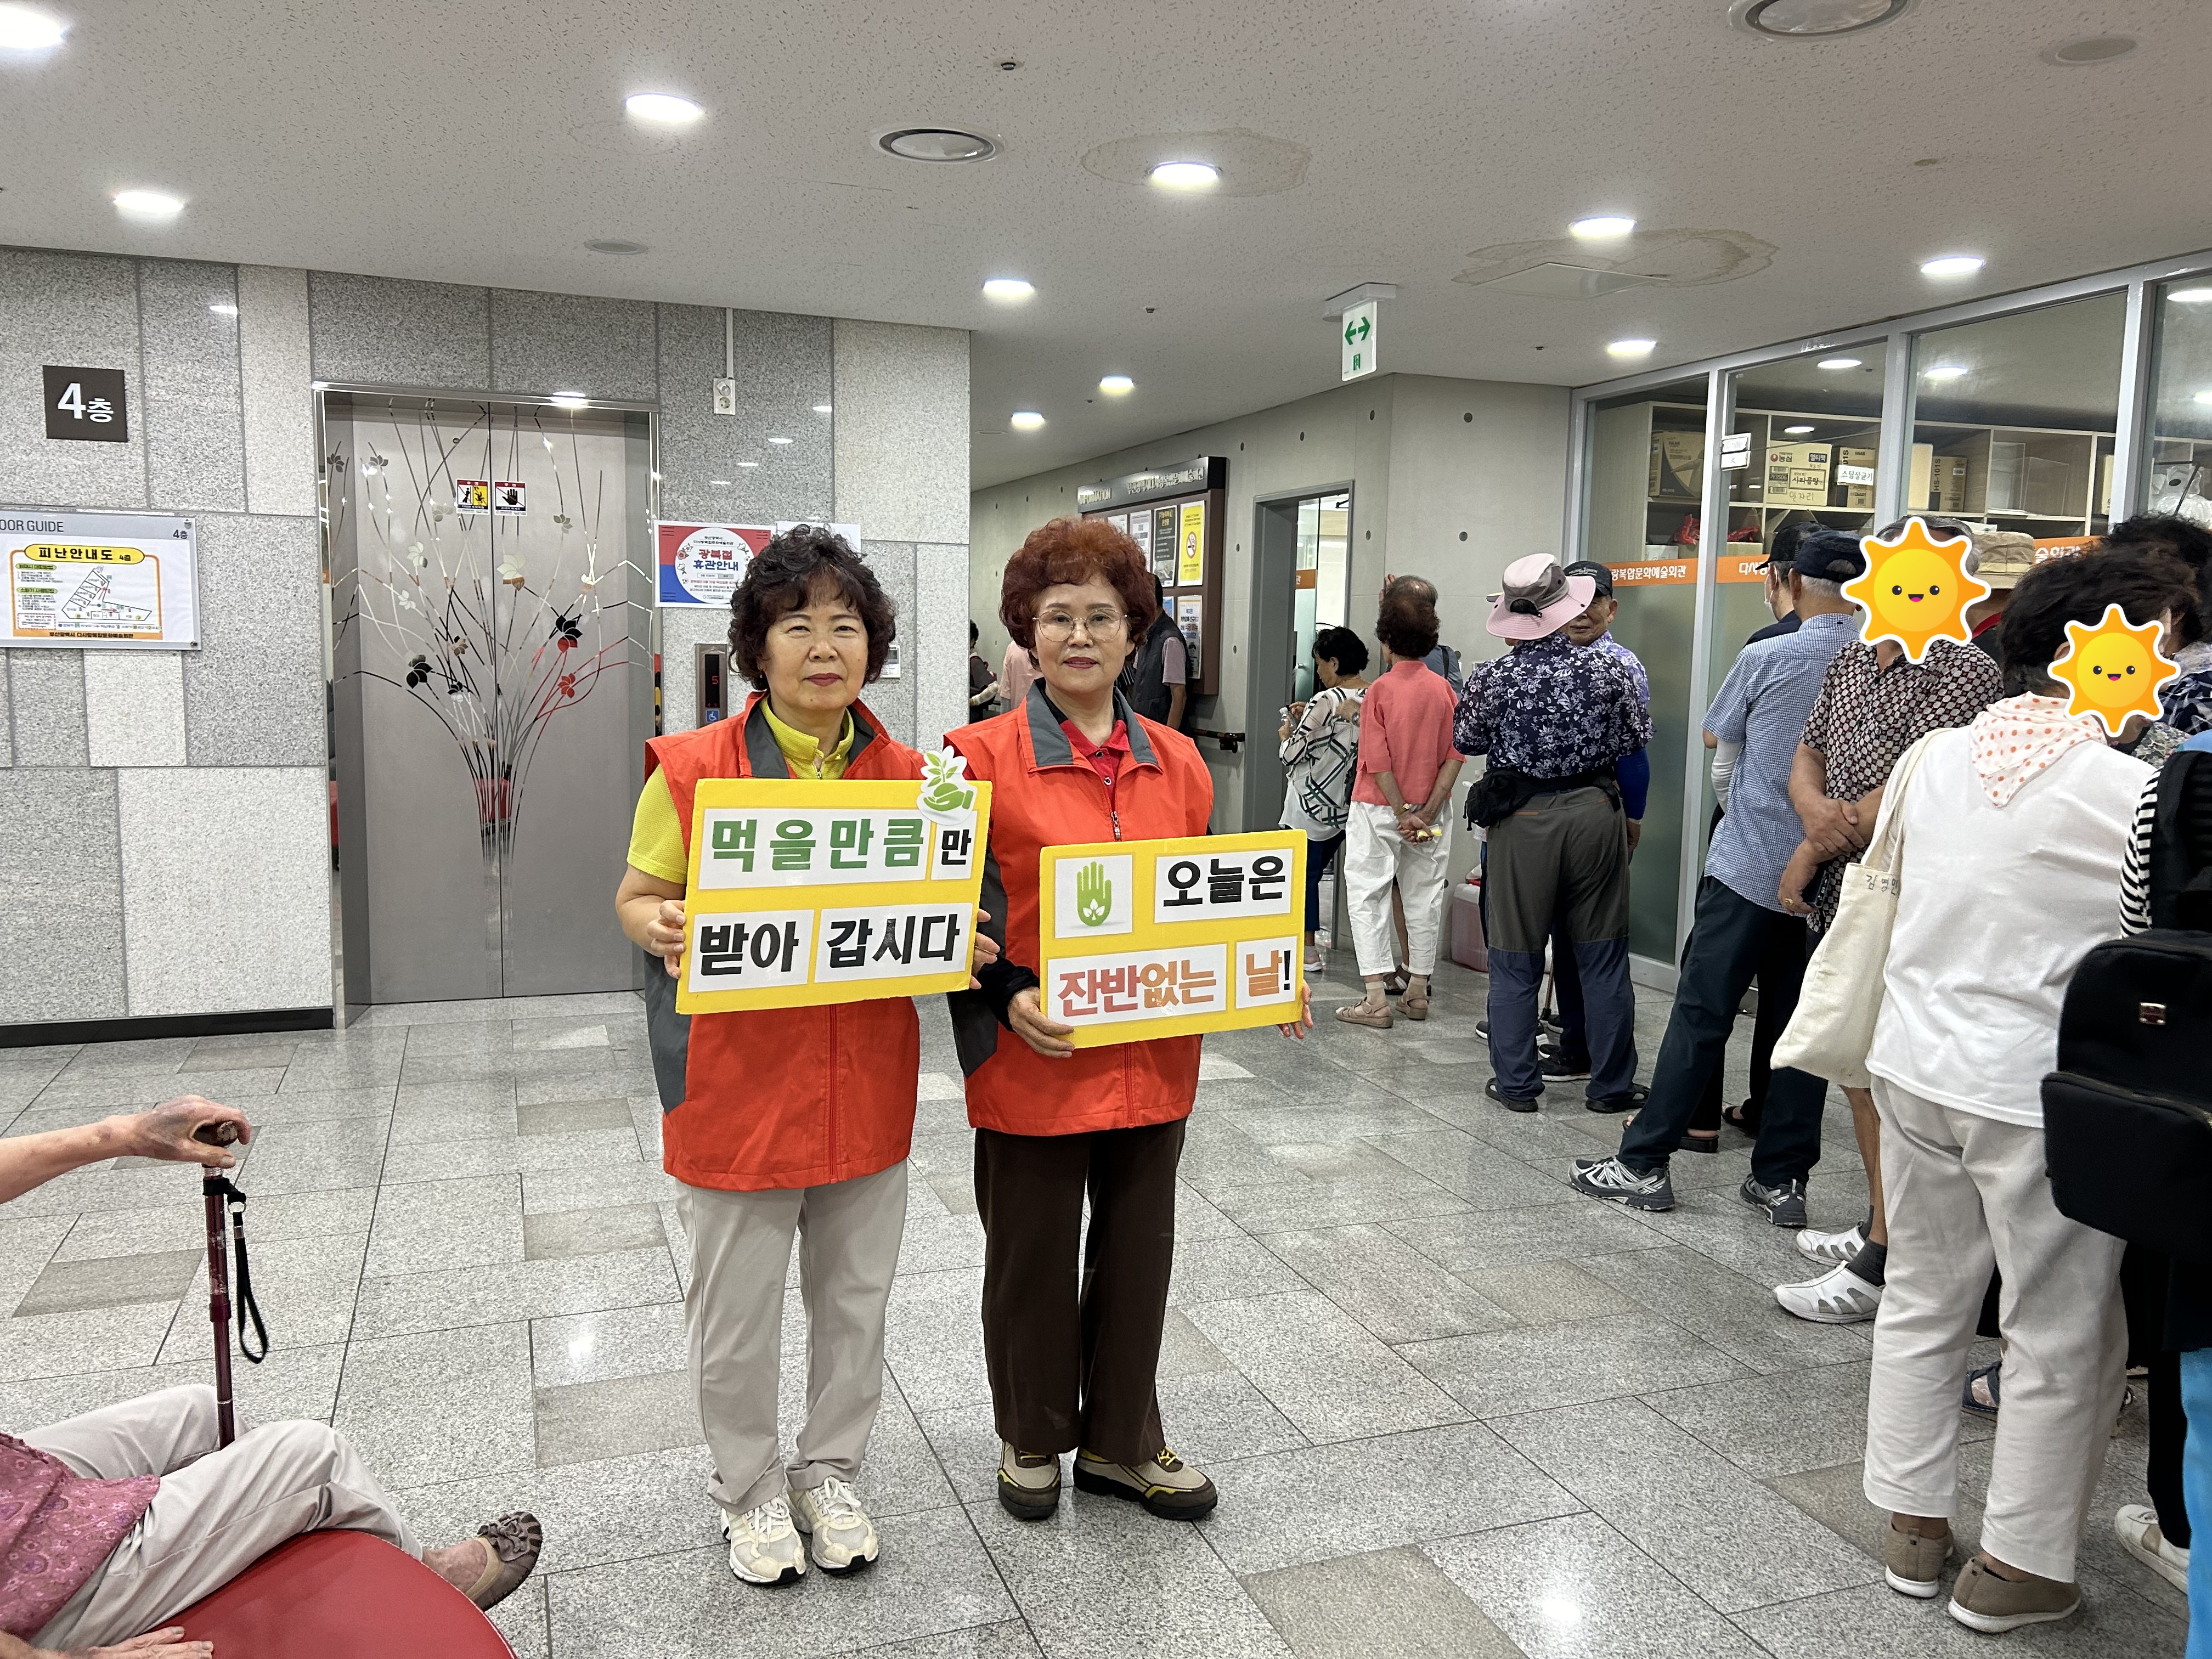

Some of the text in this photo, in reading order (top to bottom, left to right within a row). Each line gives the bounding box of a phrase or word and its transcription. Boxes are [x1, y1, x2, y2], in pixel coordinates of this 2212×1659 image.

[58, 382, 114, 423] 4층
[1841, 470, 1873, 482] 스팀살균기
[27, 520, 64, 532] GUIDE
[173, 529, 188, 539] 4층
[39, 547, 113, 560] 피난안내도
[698, 549, 732, 560] 광복절
[693, 560, 738, 571] 휴관안내
[712, 675, 719, 685] 5
[1163, 855, 1286, 907] 오늘은
[699, 913, 960, 976] 받아 갑시다
[1058, 949, 1291, 1017] 잔반없는 날!
